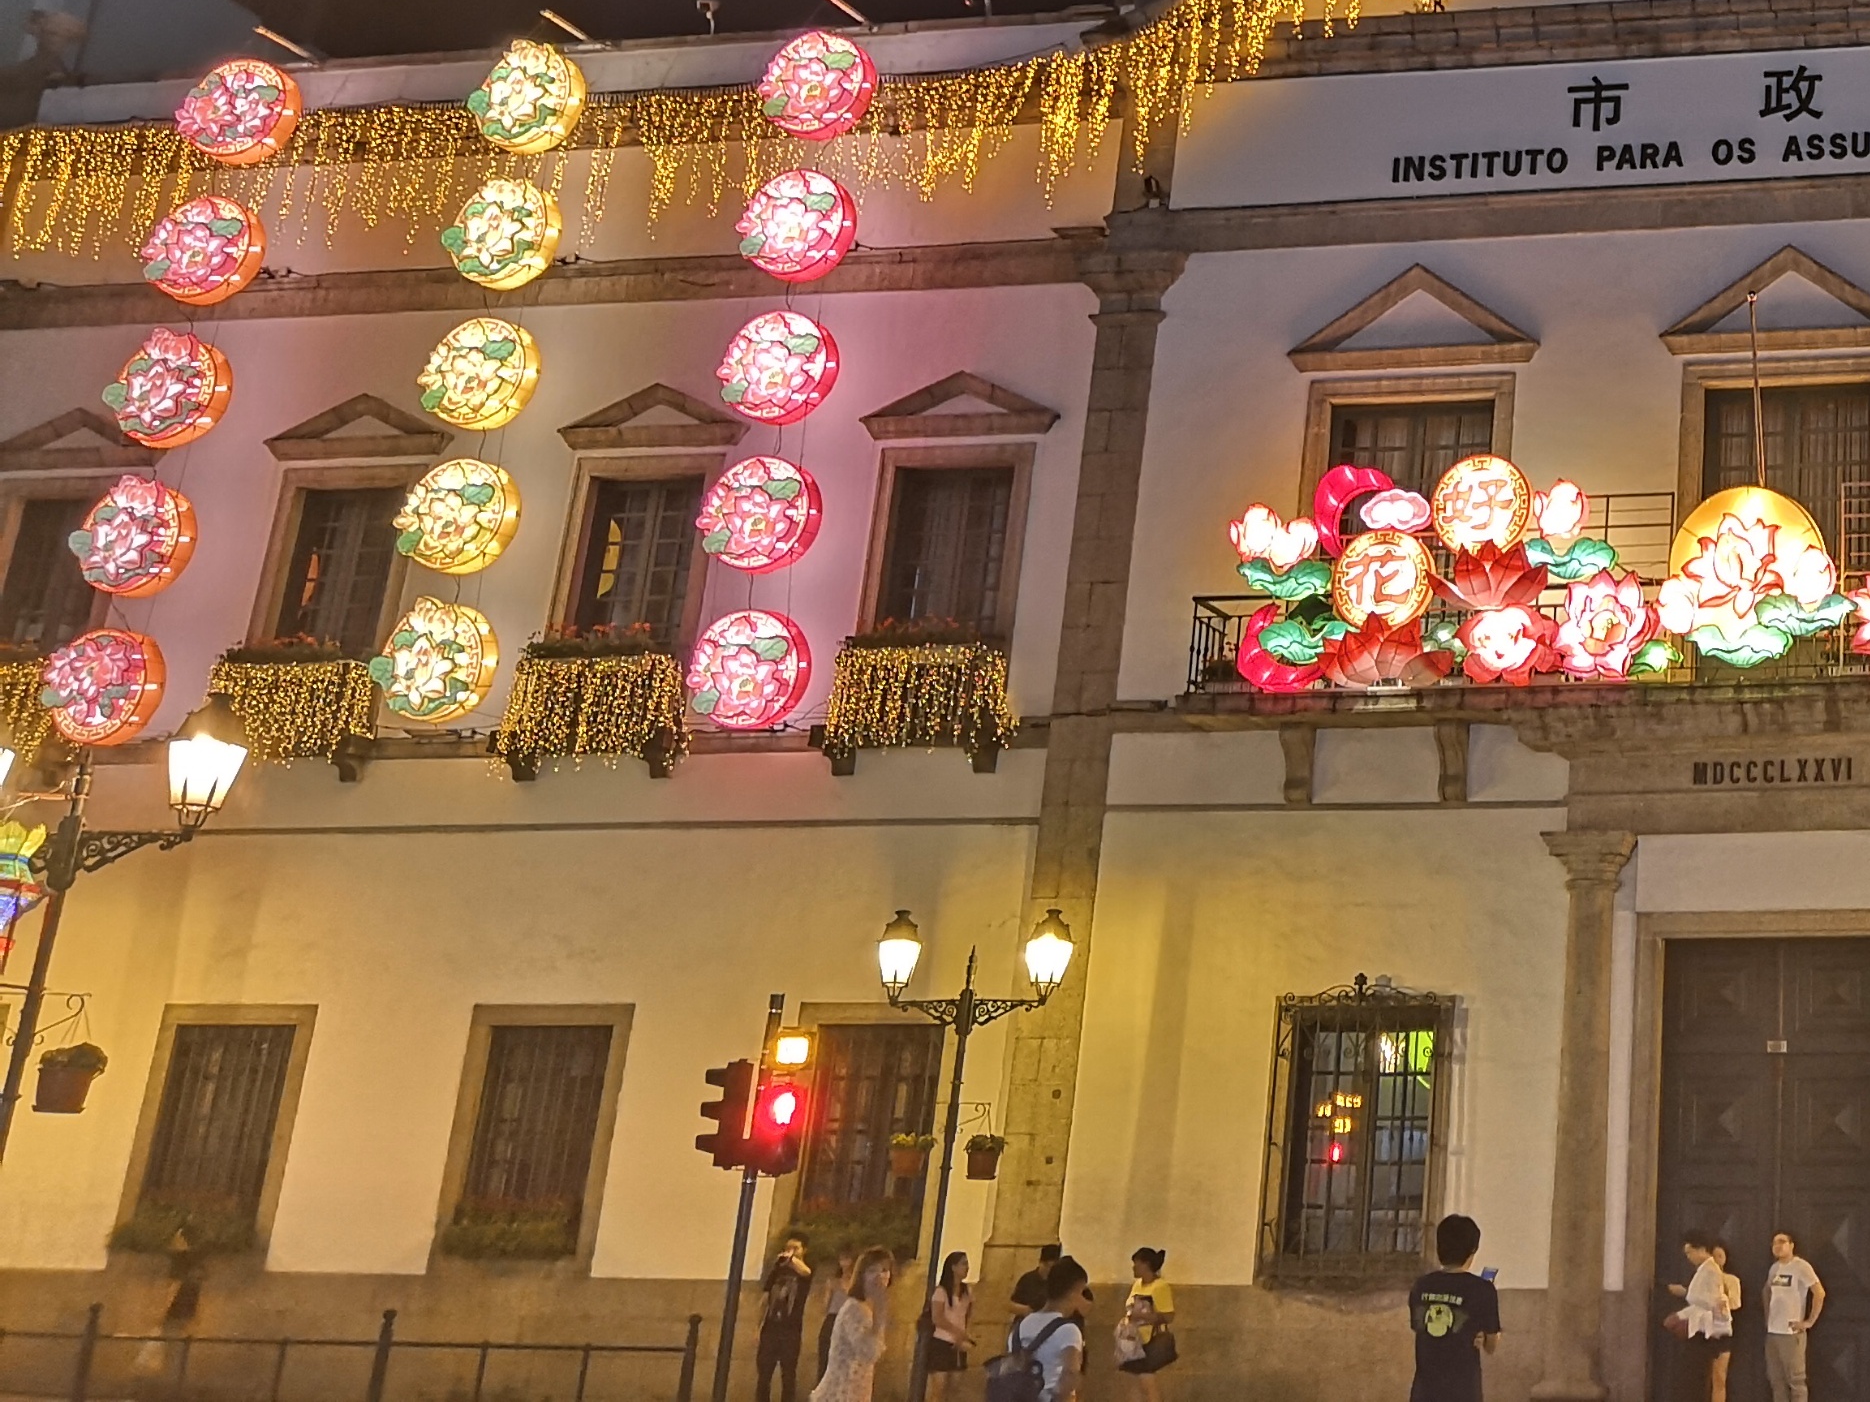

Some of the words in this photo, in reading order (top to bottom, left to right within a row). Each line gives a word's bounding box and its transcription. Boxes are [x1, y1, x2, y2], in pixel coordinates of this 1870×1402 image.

[1391, 150, 1569, 184] INSTITUTO
[1596, 143, 1684, 172] PARA
[1711, 136, 1757, 166] OS
[1442, 478, 1513, 531] 好
[1345, 549, 1411, 606] 花
[1692, 756, 1854, 786] MDCCCLXXVI
